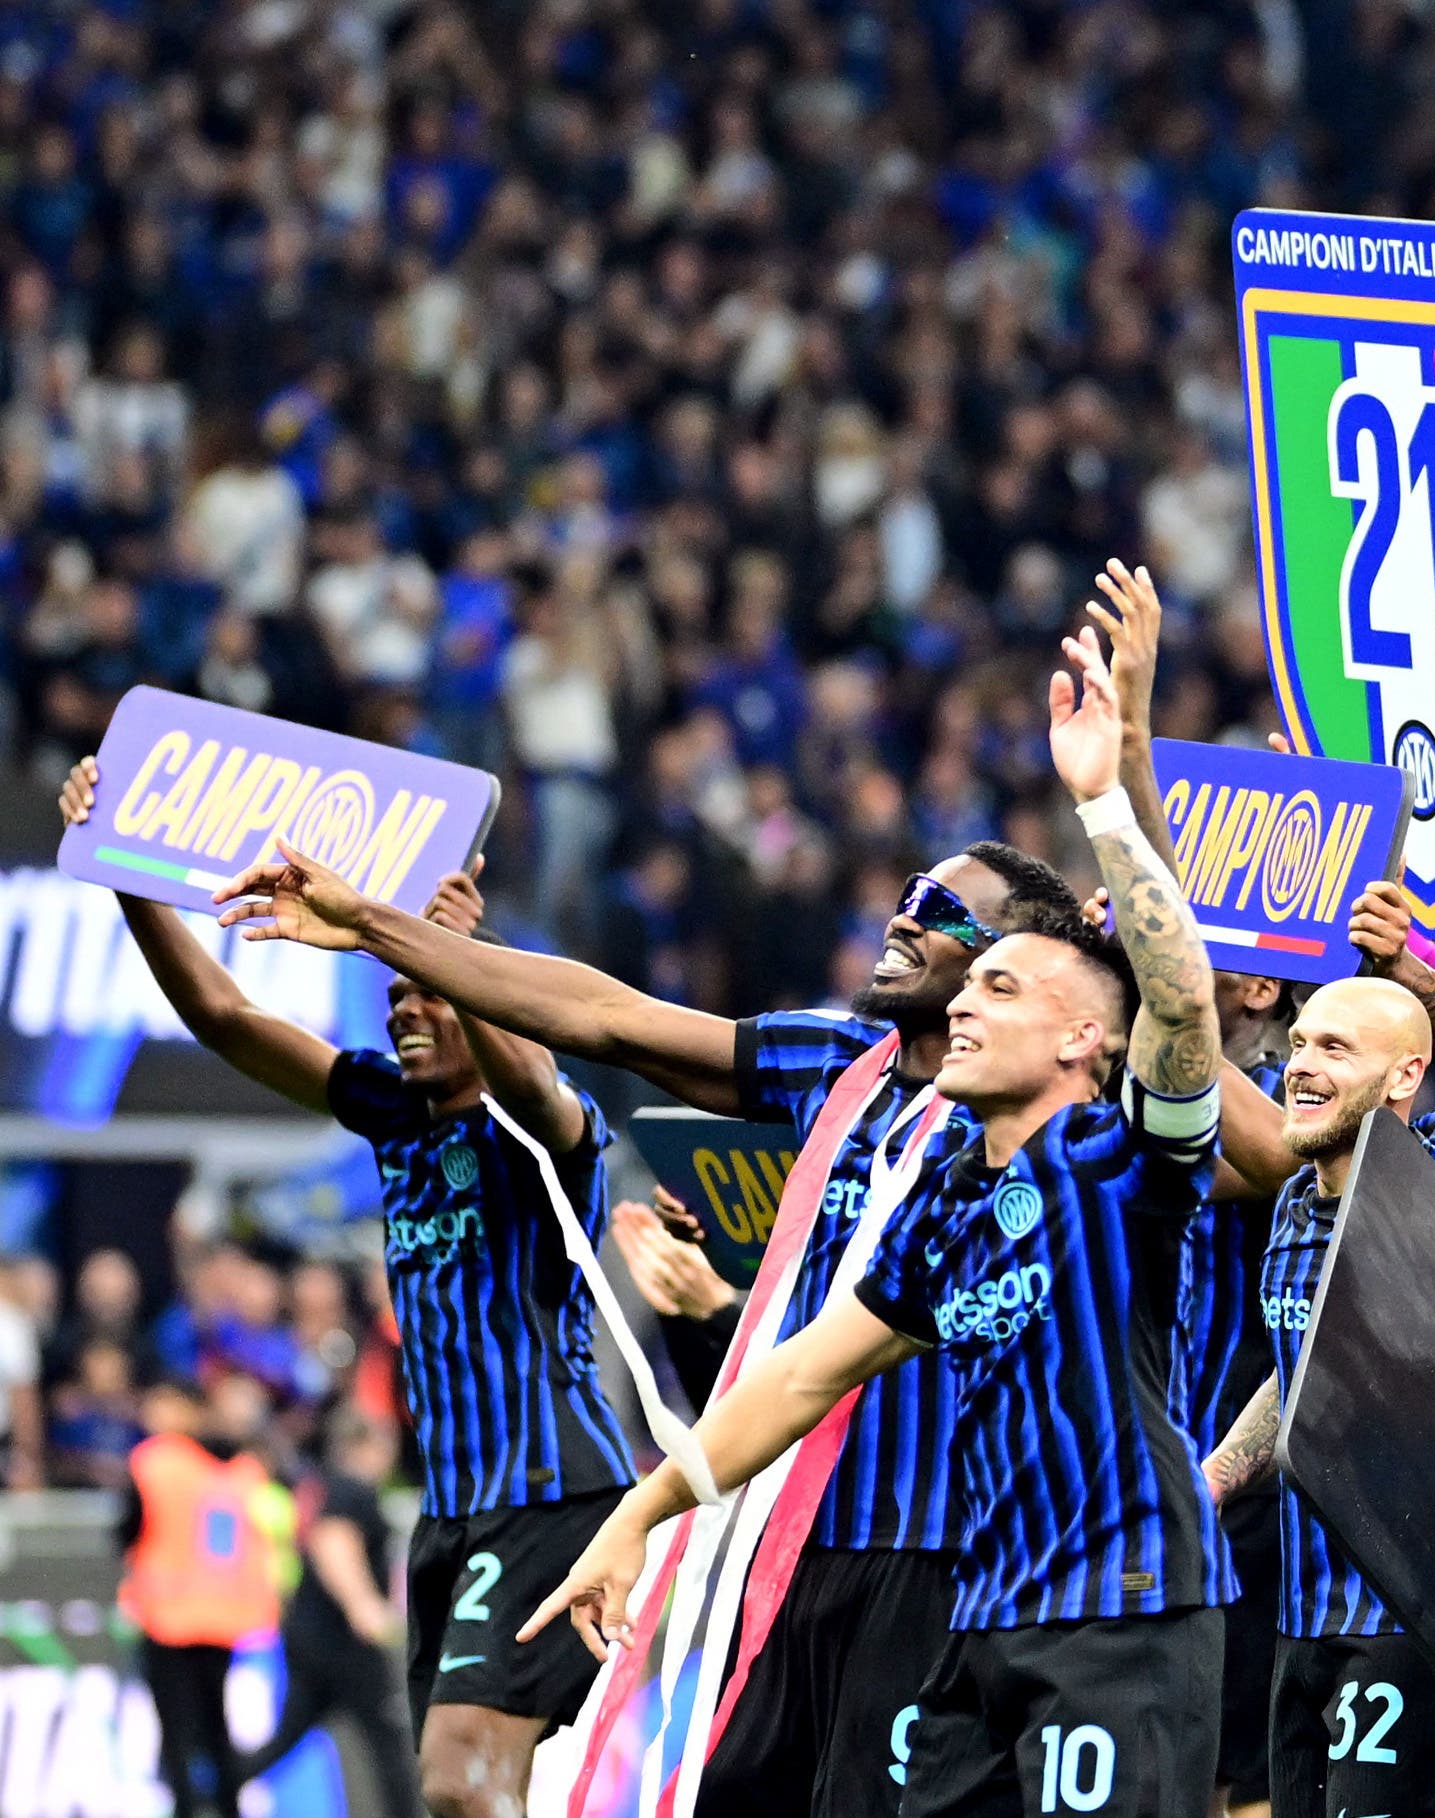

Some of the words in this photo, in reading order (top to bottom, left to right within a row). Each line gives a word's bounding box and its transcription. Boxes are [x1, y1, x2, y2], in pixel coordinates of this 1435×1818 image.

[1236, 226, 1356, 272] CAMPIONI
[113, 730, 448, 903] CAMPIONI
[453, 1551, 502, 1621] 2
[1327, 1680, 1404, 1765] 32
[1040, 1723, 1116, 1813] 10
